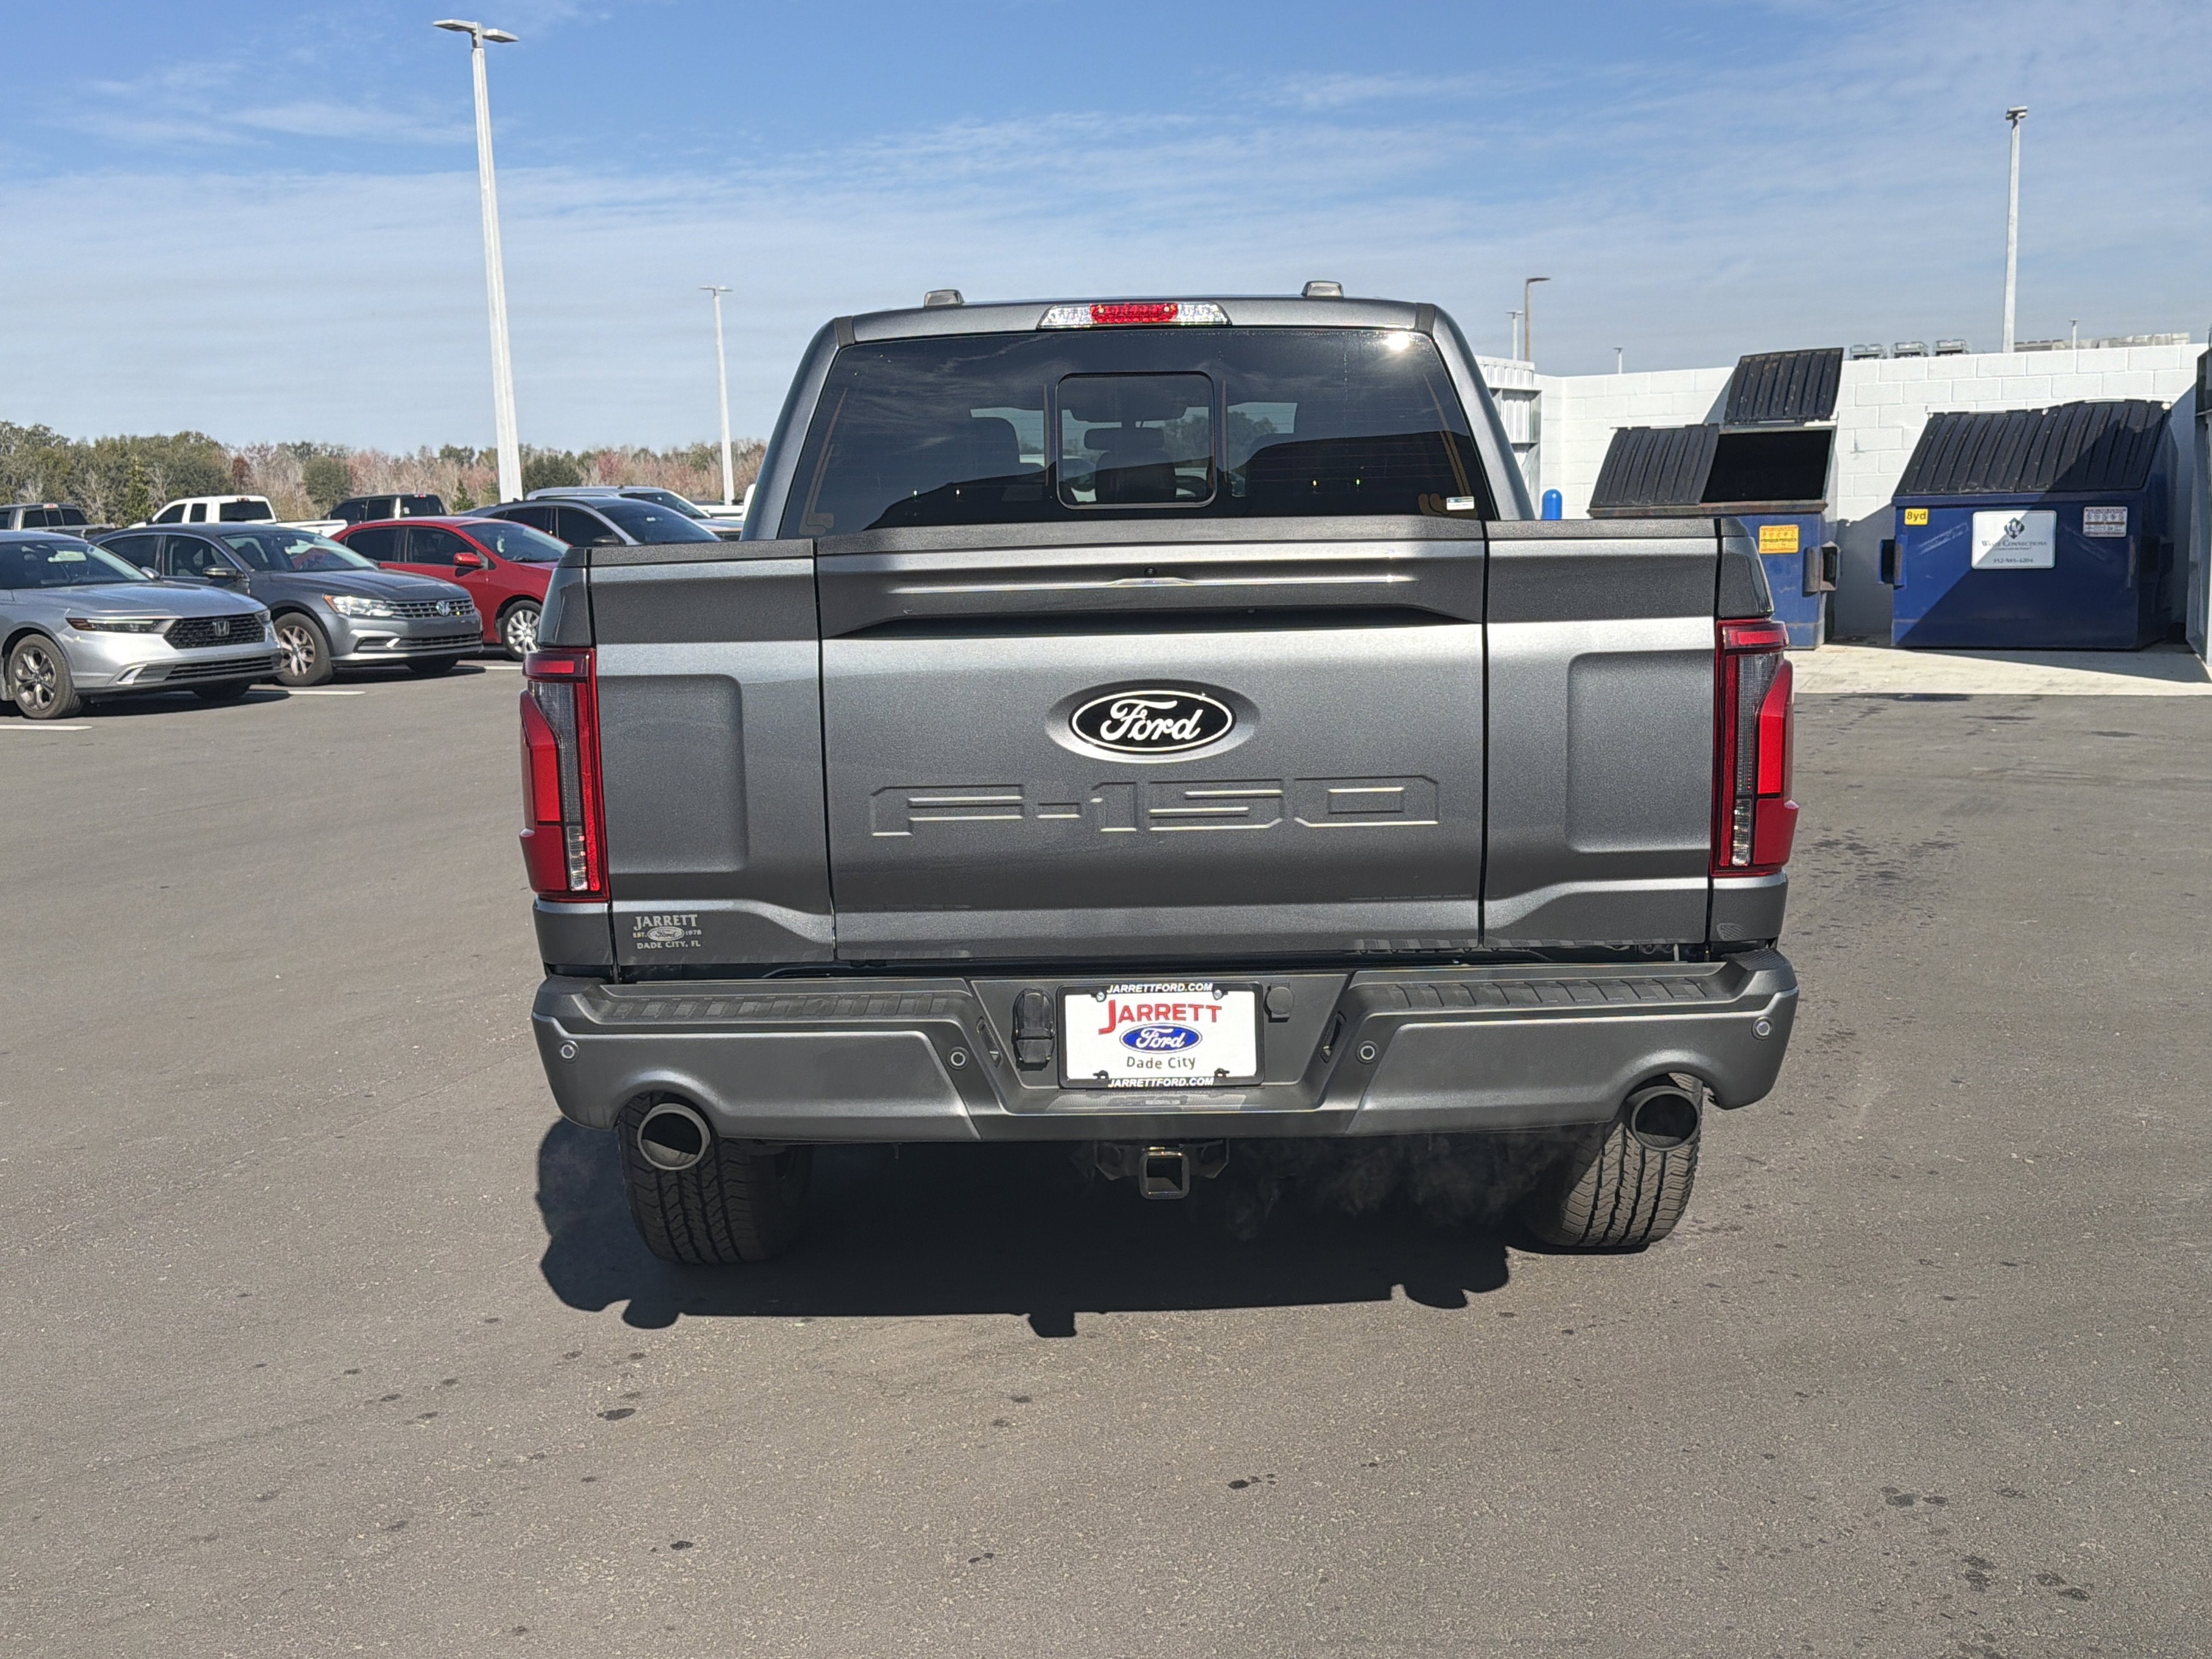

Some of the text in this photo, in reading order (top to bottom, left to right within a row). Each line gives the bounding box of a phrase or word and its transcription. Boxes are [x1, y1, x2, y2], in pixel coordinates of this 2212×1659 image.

[1906, 511, 1926, 522] 8yd
[1101, 699, 1203, 741] Ford
[871, 775, 1439, 836] F-150
[633, 914, 698, 931] JARRETT
[654, 929, 676, 938] Ford
[1107, 983, 1213, 994] JARRETTFORD.COM
[1098, 1000, 1222, 1035] JARRETT
[1136, 1028, 1186, 1048] Ford
[1127, 1056, 1196, 1070] Dade City
[1108, 1077, 1214, 1087] JARRETTFORD.COM
